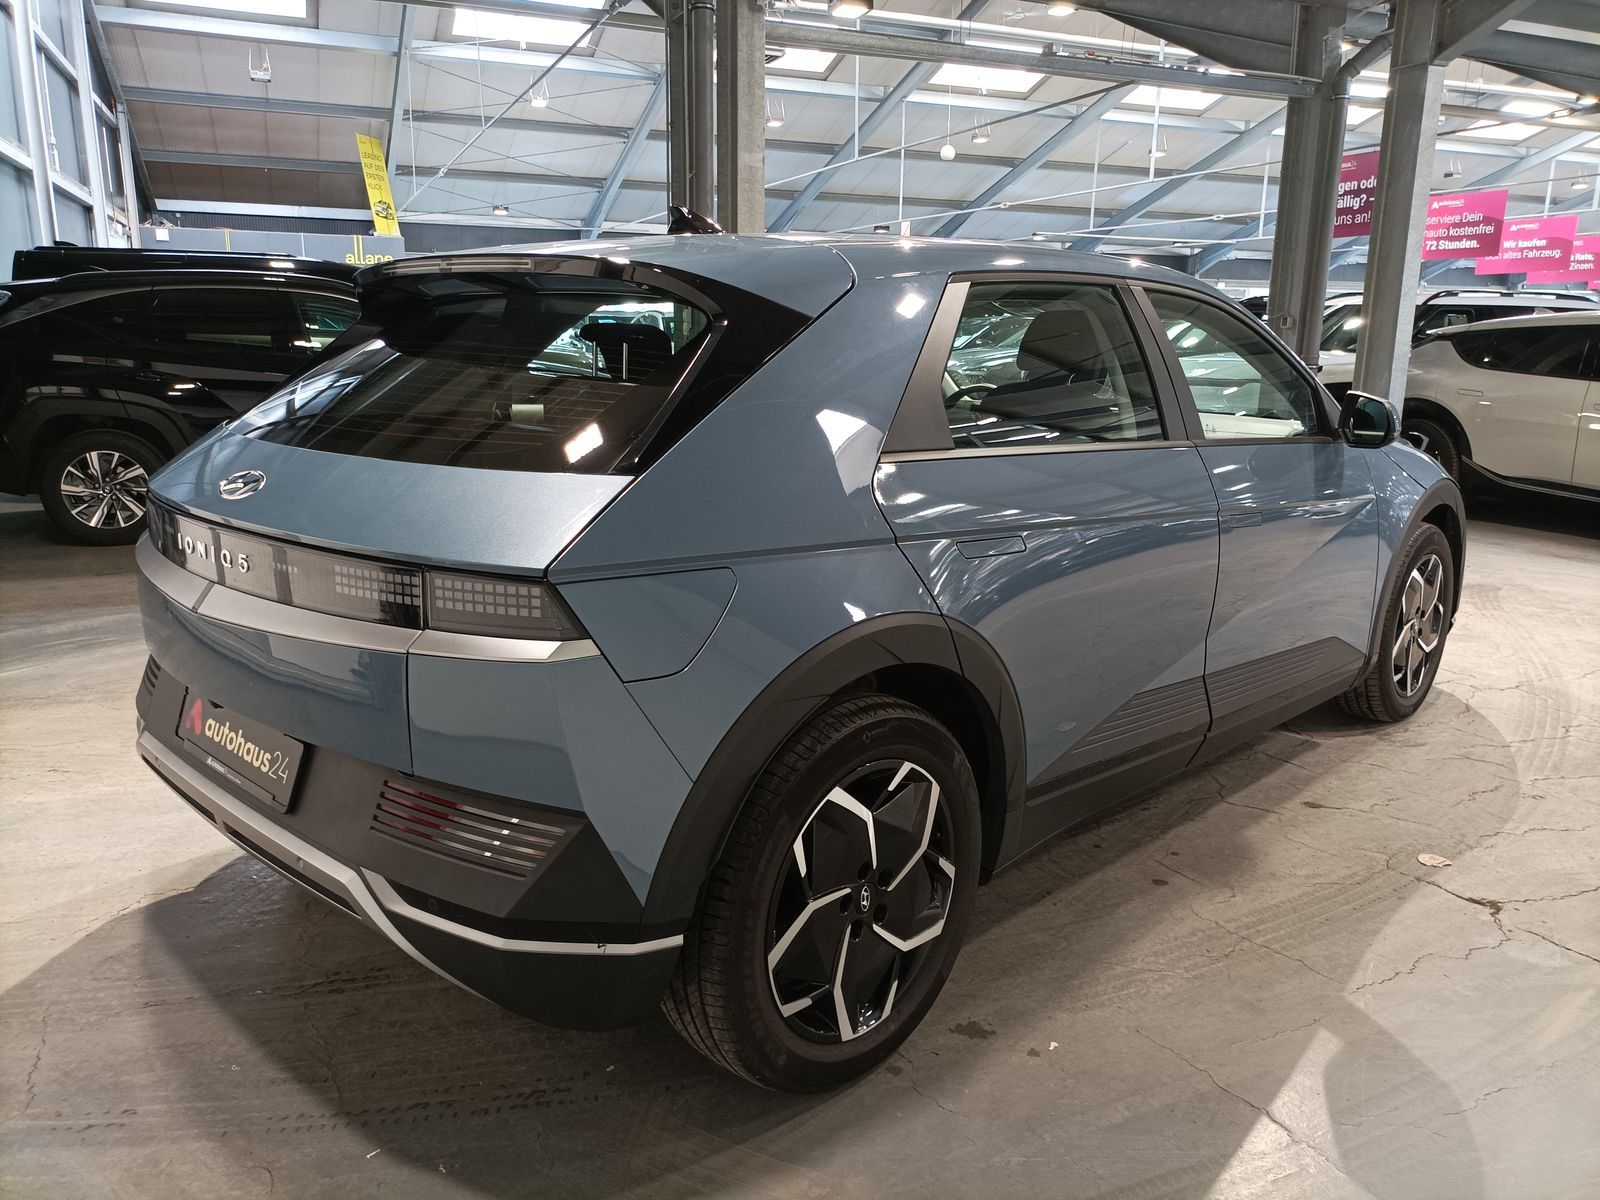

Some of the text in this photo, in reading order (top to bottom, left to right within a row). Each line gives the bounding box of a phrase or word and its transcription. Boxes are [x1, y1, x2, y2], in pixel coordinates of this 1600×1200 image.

[1334, 211, 1371, 226] uns an!
[1462, 211, 1483, 223] Dein
[1449, 222, 1495, 237] kostenfrei
[1425, 238, 1480, 251] 72 Stunden.
[1503, 238, 1547, 248] Wir kaufen
[1503, 251, 1521, 259] altes
[1523, 249, 1562, 258] Fahrzeug.
[1569, 262, 1595, 271] Zinsen.
[177, 532, 249, 574] IONIQ 5
